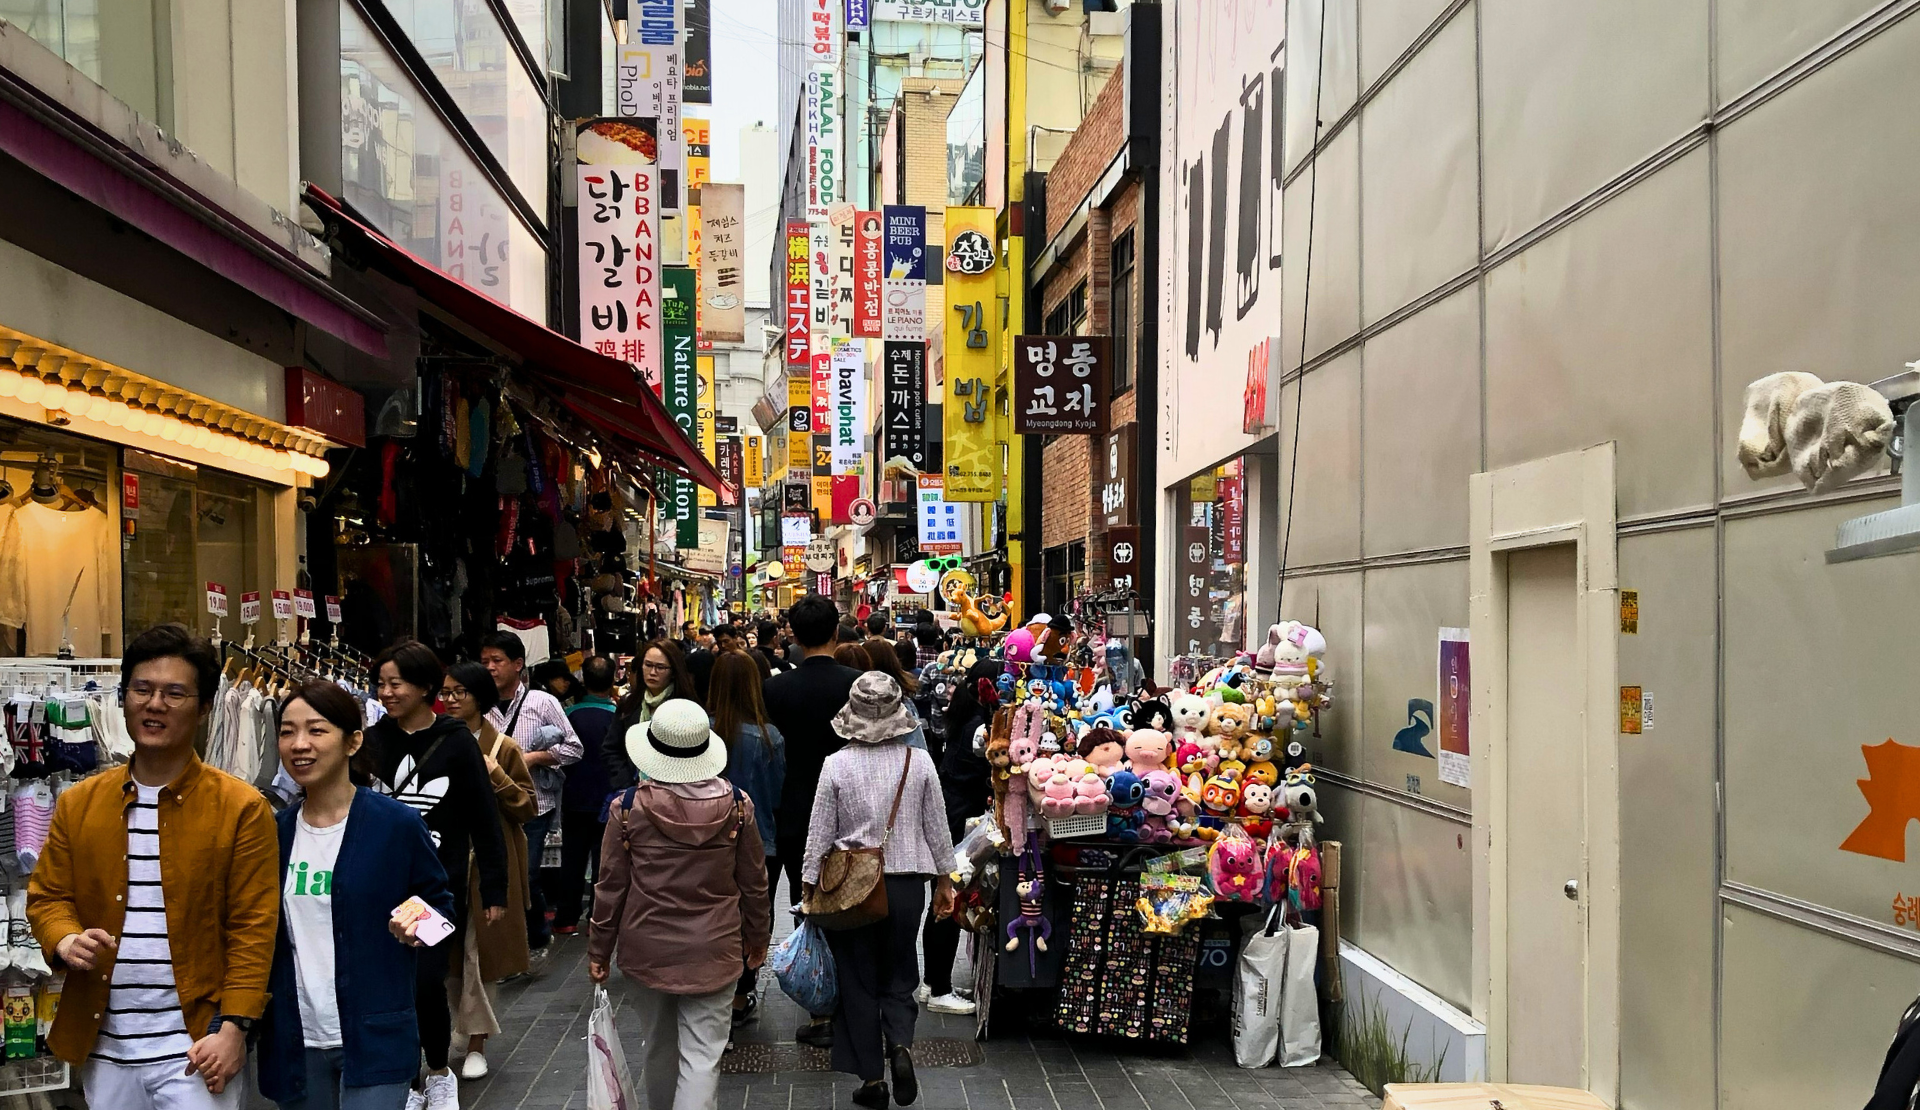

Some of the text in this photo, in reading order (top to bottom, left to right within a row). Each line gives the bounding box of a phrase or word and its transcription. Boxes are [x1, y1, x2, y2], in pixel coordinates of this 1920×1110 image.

[897, 6, 937, 21] 구르카
[812, 12, 831, 54] 떡볶이
[667, 94, 678, 141] 프리미엄
[808, 72, 818, 145] GURKHA
[820, 73, 834, 206] HALAL FOOD
[706, 216, 739, 229] 제임스
[712, 233, 733, 243] 치즈
[889, 216, 917, 226] MINI
[889, 226, 921, 236] BEER
[584, 170, 631, 333] 닭갈비
[635, 173, 653, 330] BBANDAK
[708, 248, 739, 262] 등갈비
[889, 236, 912, 246] PUB
[953, 239, 991, 270] 충무
[862, 240, 881, 317] 홍콩반점
[788, 236, 809, 360] 横浜エステ
[897, 316, 923, 324] PIANO
[594, 338, 646, 362] 鸡排
[890, 349, 911, 361] 수제
[953, 301, 990, 423] 김밥
[1026, 341, 1098, 378] 명동
[675, 335, 691, 407] Nature
[914, 350, 922, 389] Homemade
[837, 368, 856, 446] baviphat
[891, 364, 911, 429] 돈까스
[1026, 384, 1097, 418] 교자
[914, 409, 922, 429] cutlet
[1026, 419, 1097, 431] Myeongdong Kyoja
